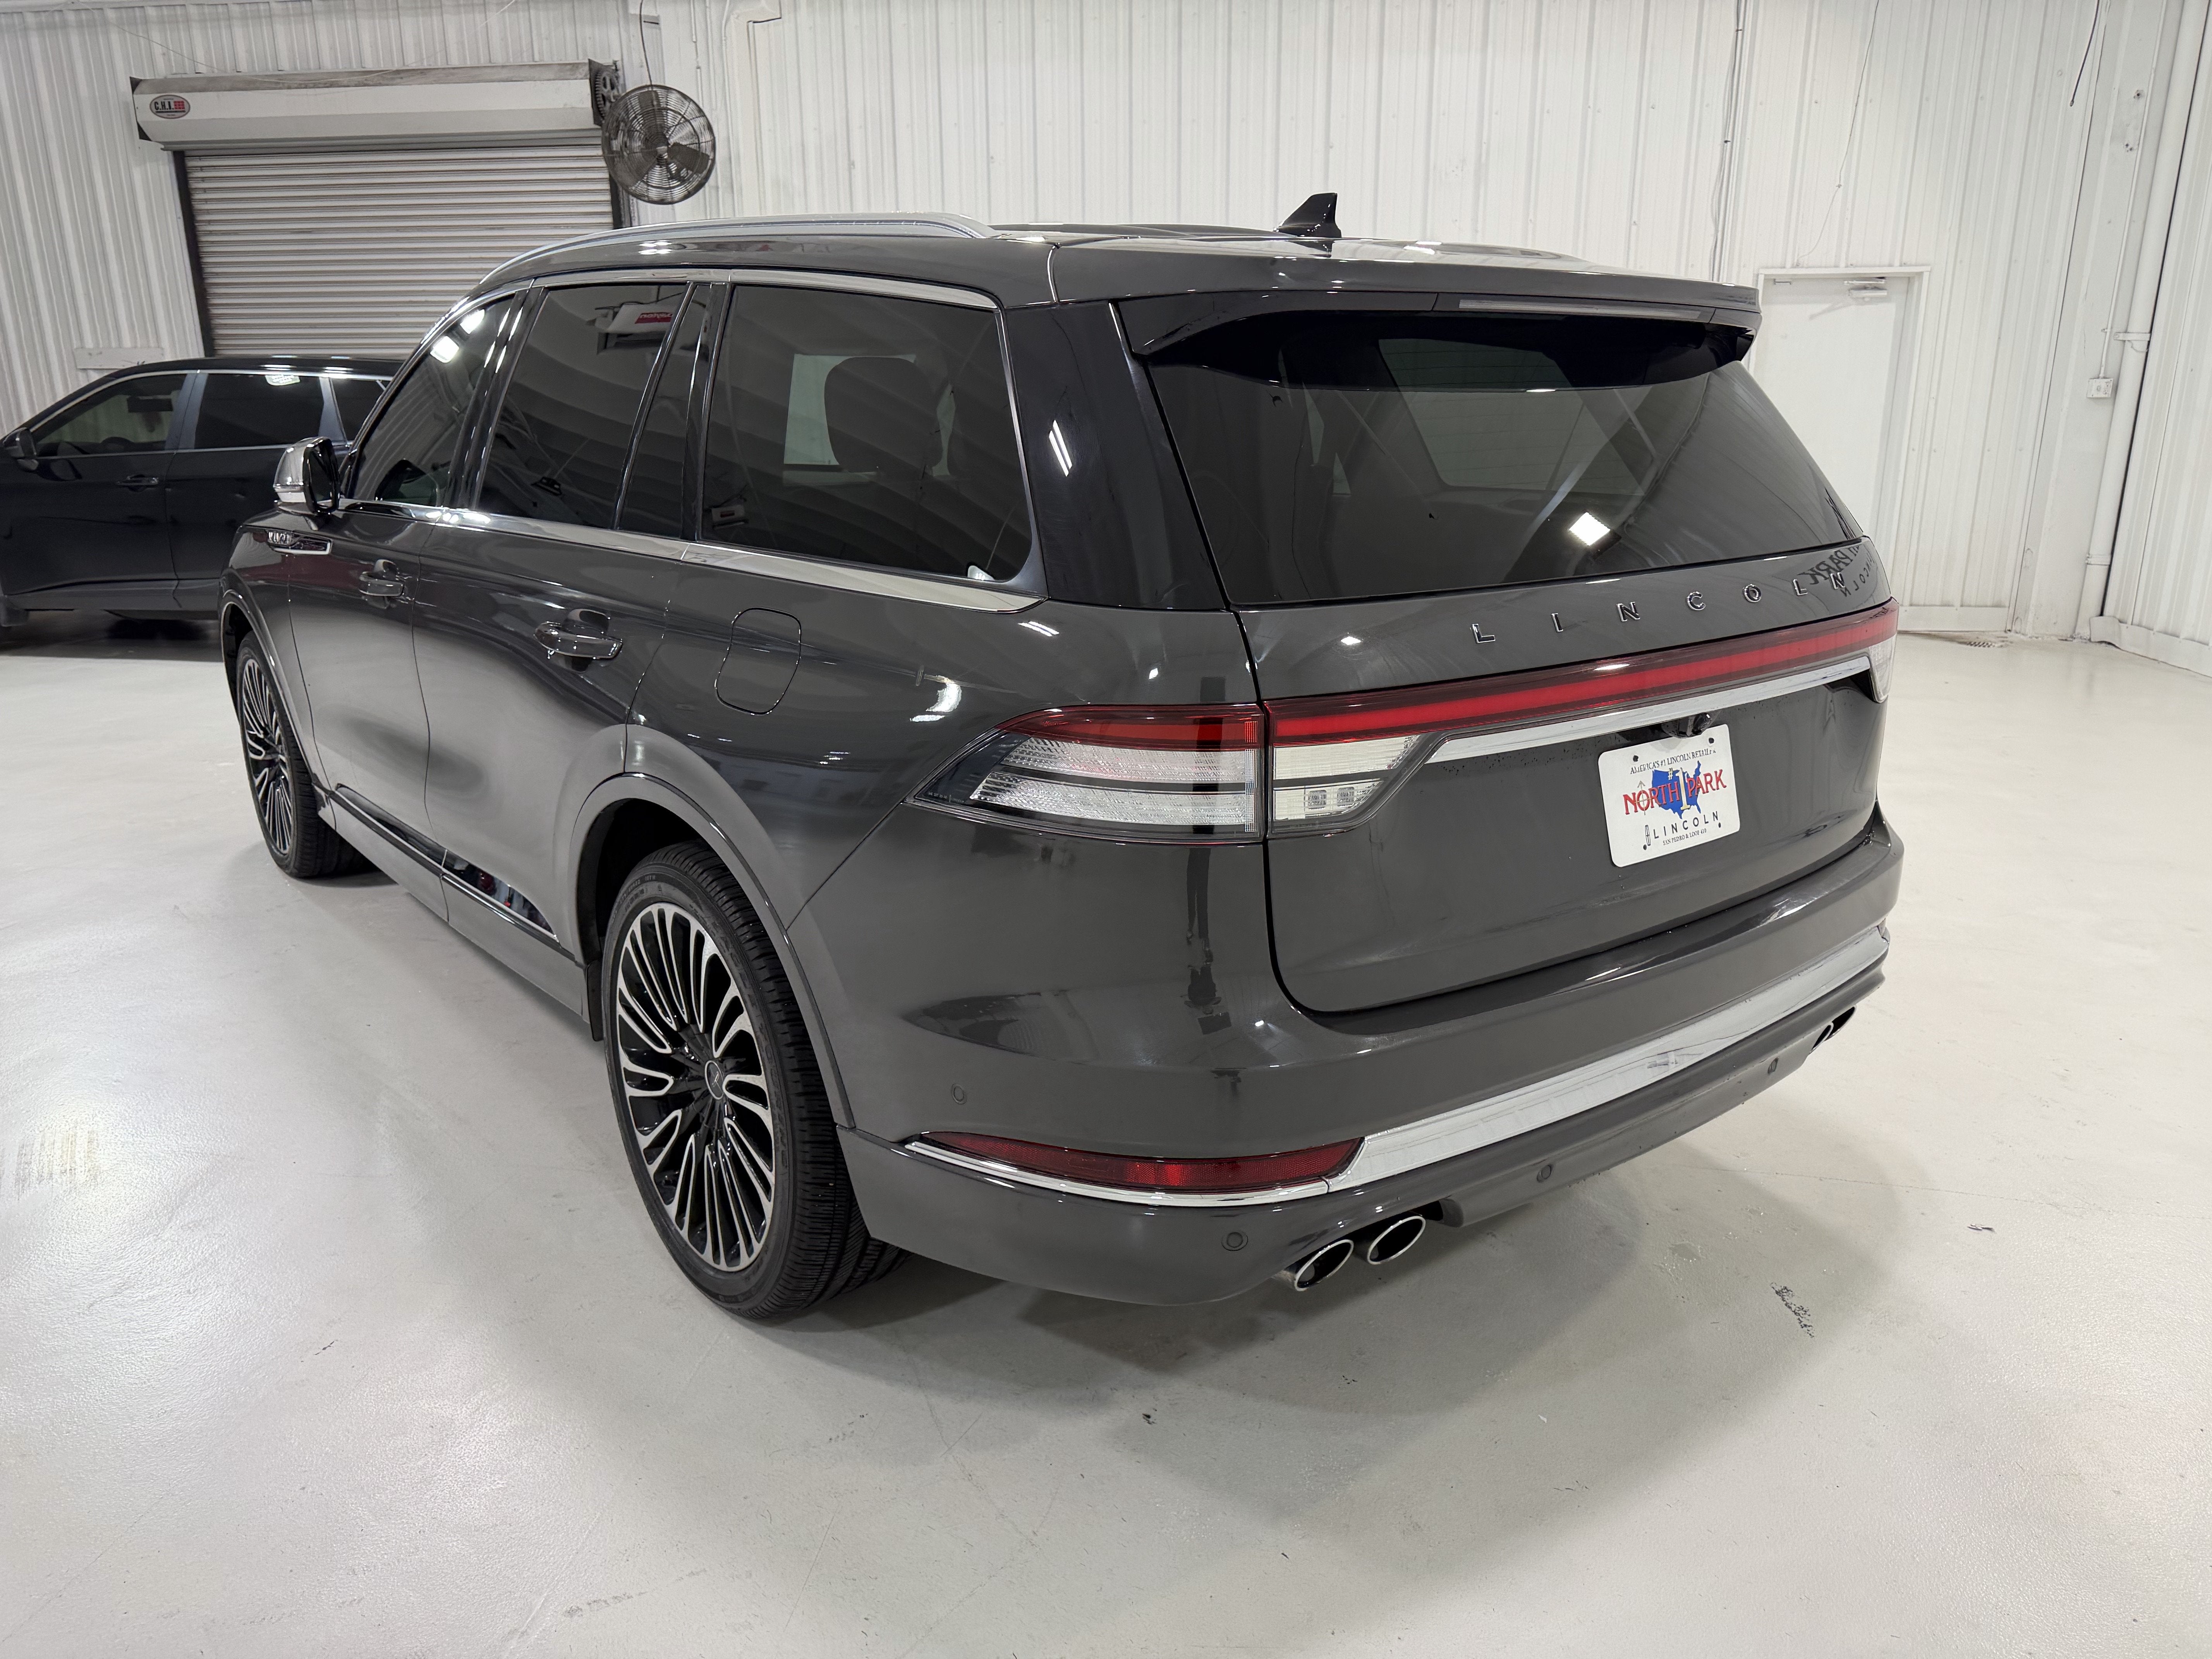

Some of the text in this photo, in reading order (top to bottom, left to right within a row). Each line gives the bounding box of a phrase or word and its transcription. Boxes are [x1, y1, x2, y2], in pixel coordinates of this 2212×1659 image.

[1471, 572, 1846, 644] LINCOLN
[1630, 761, 1660, 774] AMERICA'S
[1667, 753, 1691, 765] LINCOLN
[1623, 769, 1727, 815] NORTH PARK
[1653, 811, 1719, 840] LINCOLN
[1671, 835, 1685, 843] PEDRO
